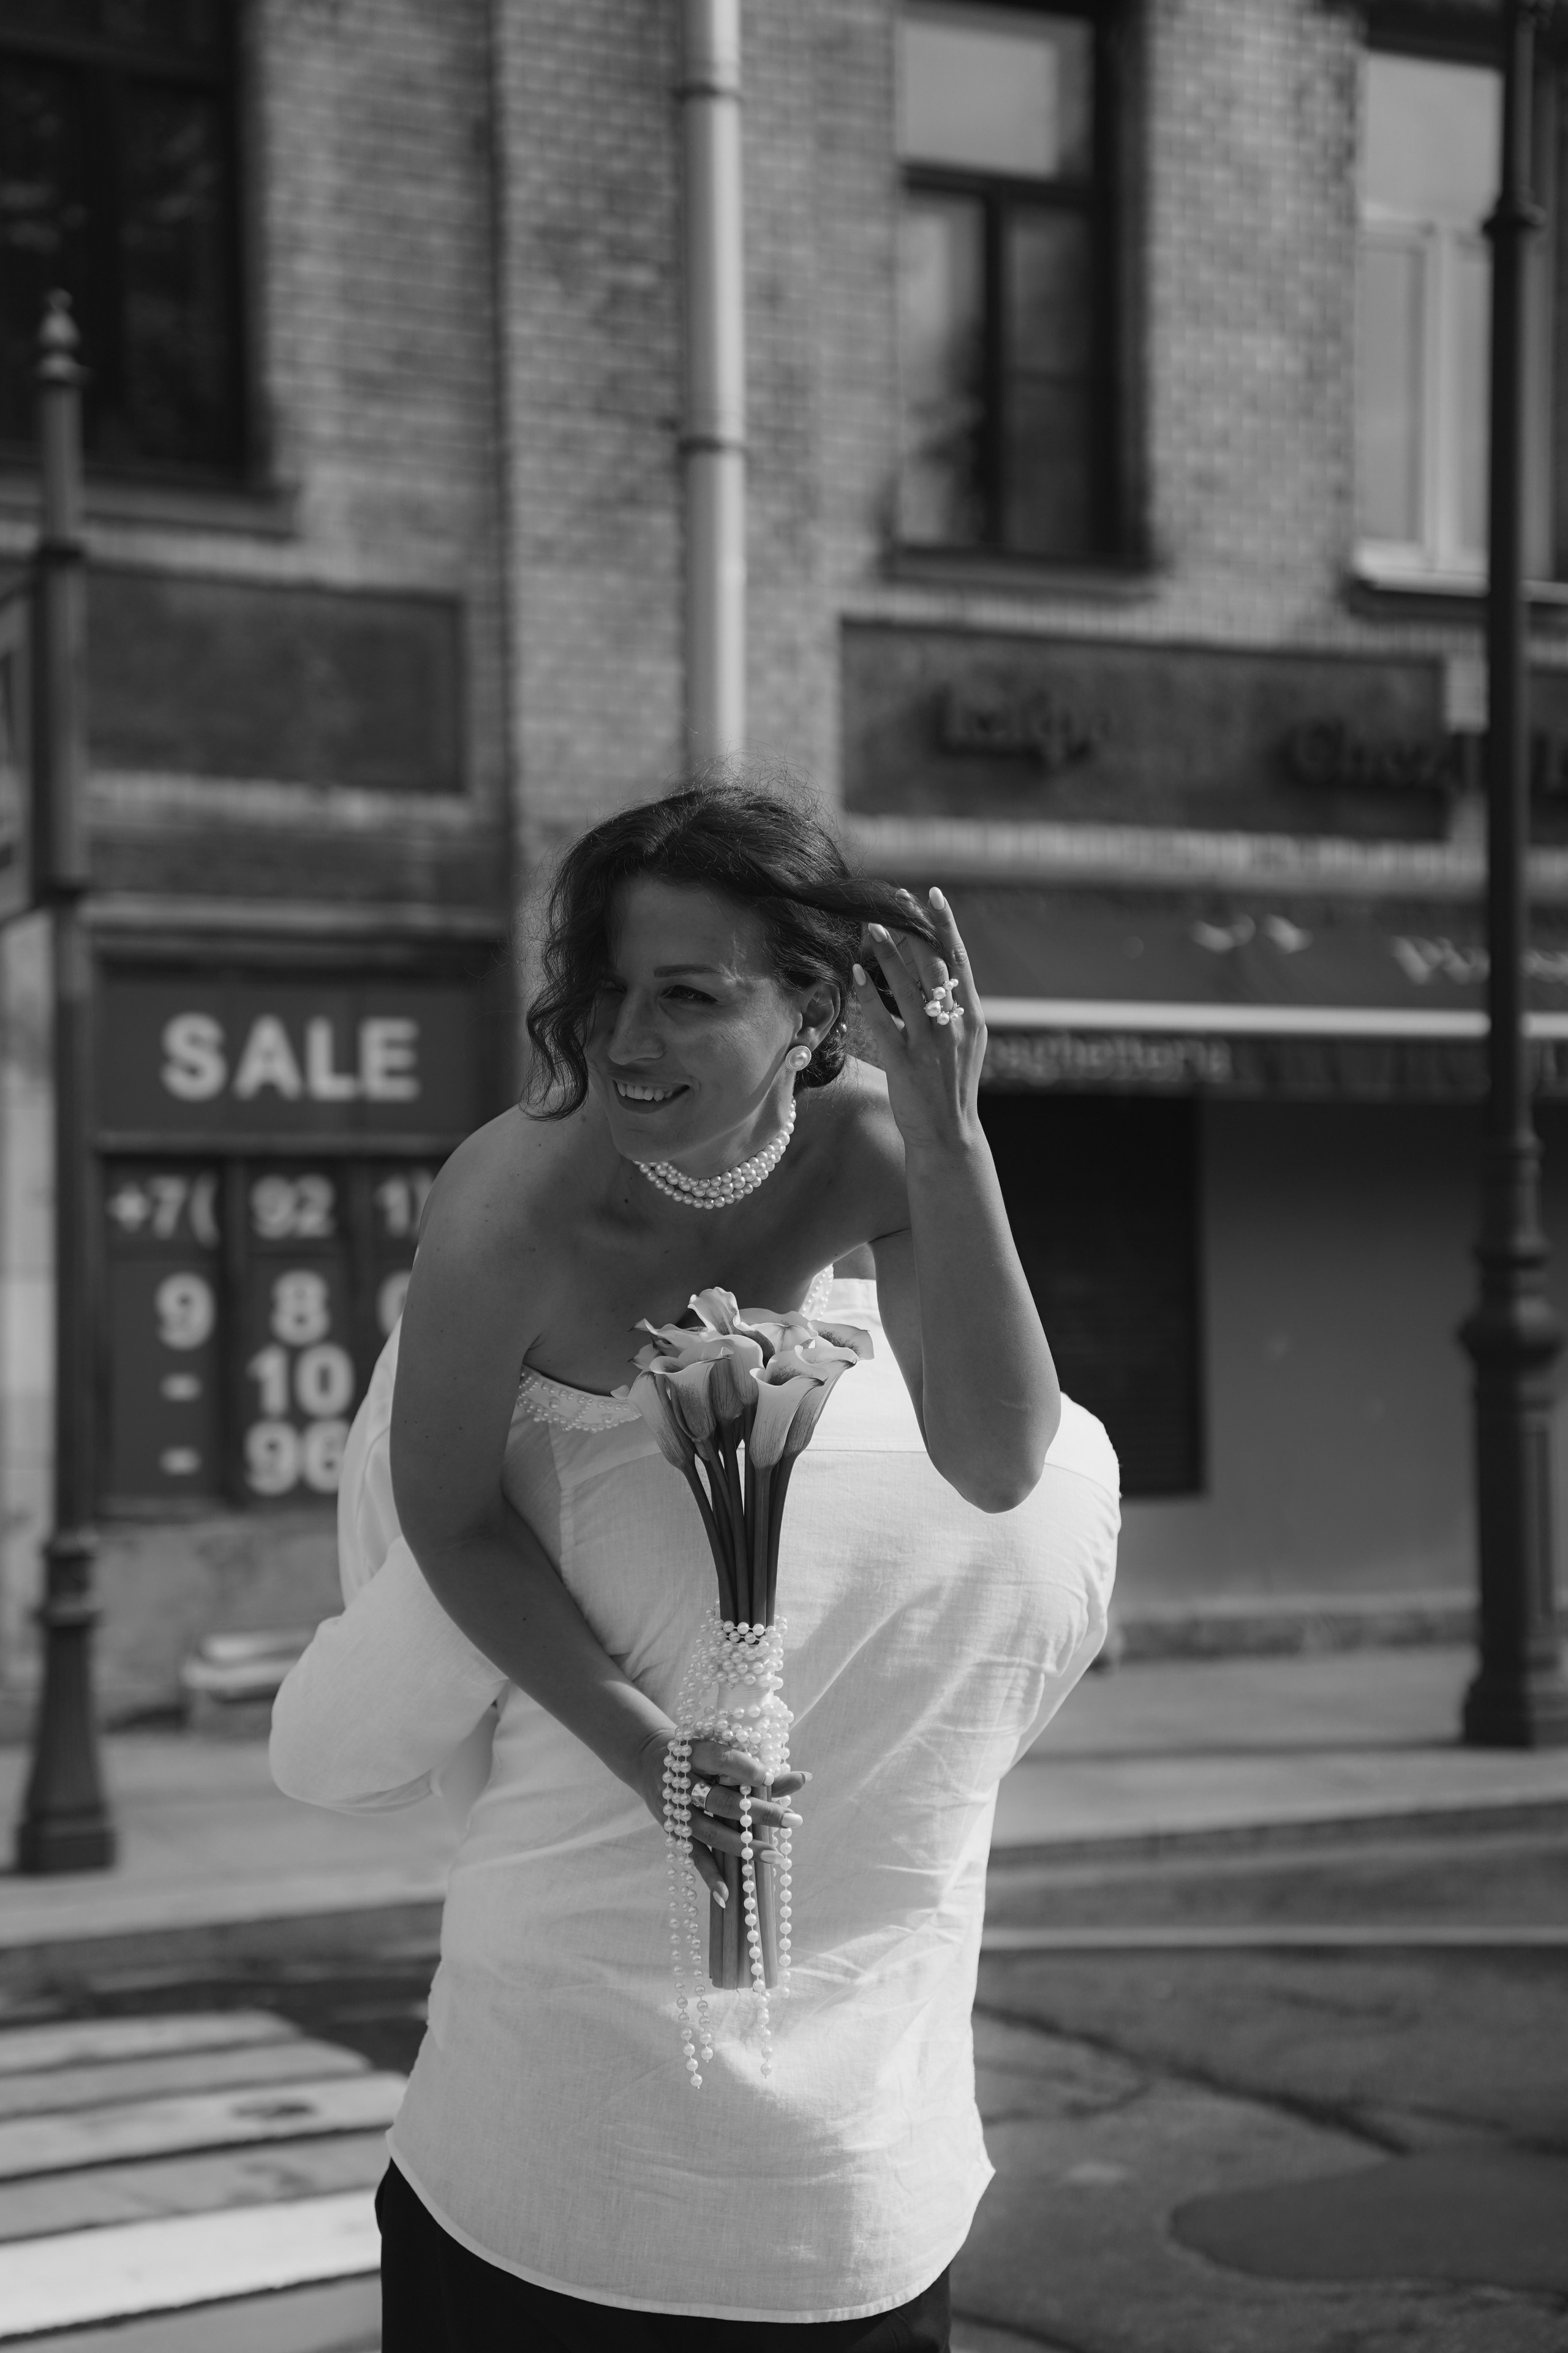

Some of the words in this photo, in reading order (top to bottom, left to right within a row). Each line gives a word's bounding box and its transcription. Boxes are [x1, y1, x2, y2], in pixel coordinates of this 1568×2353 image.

[162, 1013, 420, 1100] SALE
[252, 1176, 333, 1239] 92
[155, 1272, 214, 1350] 9
[271, 1270, 330, 1345] 8
[249, 1344, 354, 1418] 10
[247, 1419, 351, 1495] 96
